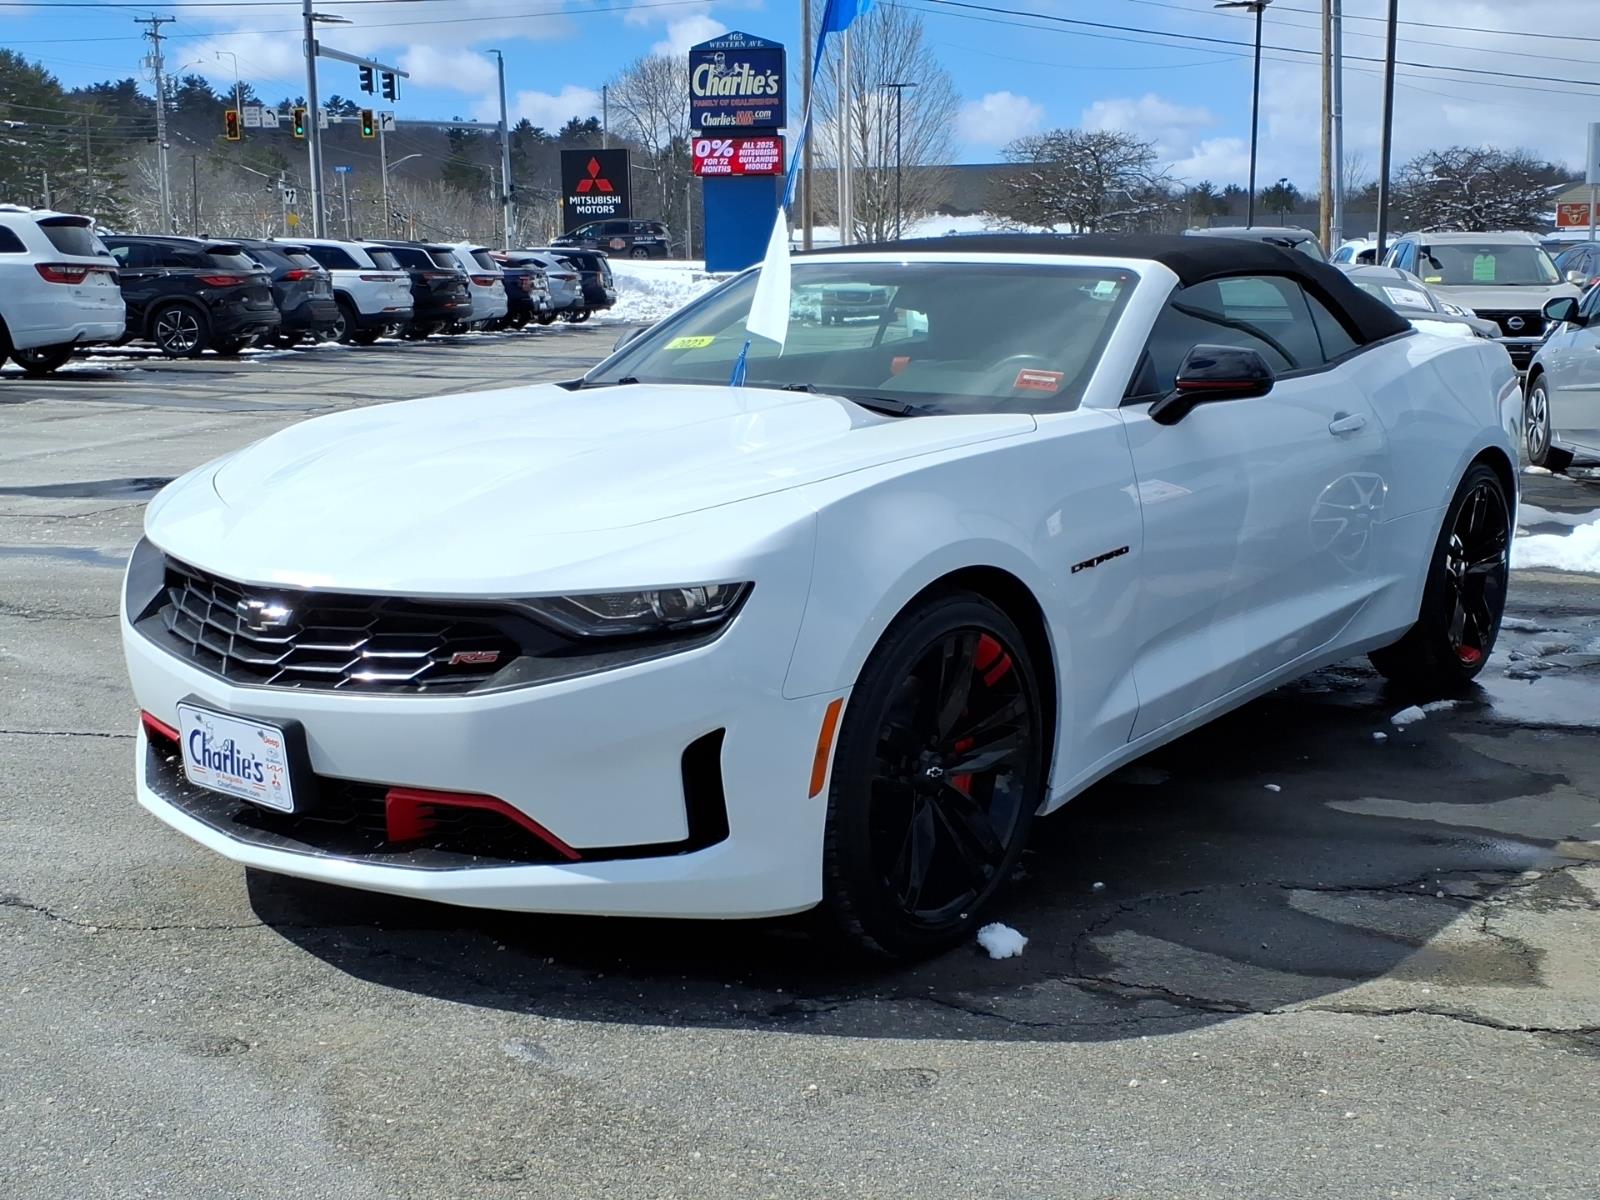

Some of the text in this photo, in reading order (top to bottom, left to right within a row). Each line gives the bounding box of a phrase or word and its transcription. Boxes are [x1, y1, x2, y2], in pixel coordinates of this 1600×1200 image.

[728, 33, 743, 41] 465
[709, 40, 746, 49] WESTERN
[692, 63, 779, 96] Charlie's
[695, 139, 734, 158] 0%
[756, 141, 774, 149] 2025
[569, 195, 621, 205] MITSUBISHI
[576, 205, 615, 214] MOTORS
[448, 650, 500, 664] RS
[189, 728, 265, 783] Charlie's
